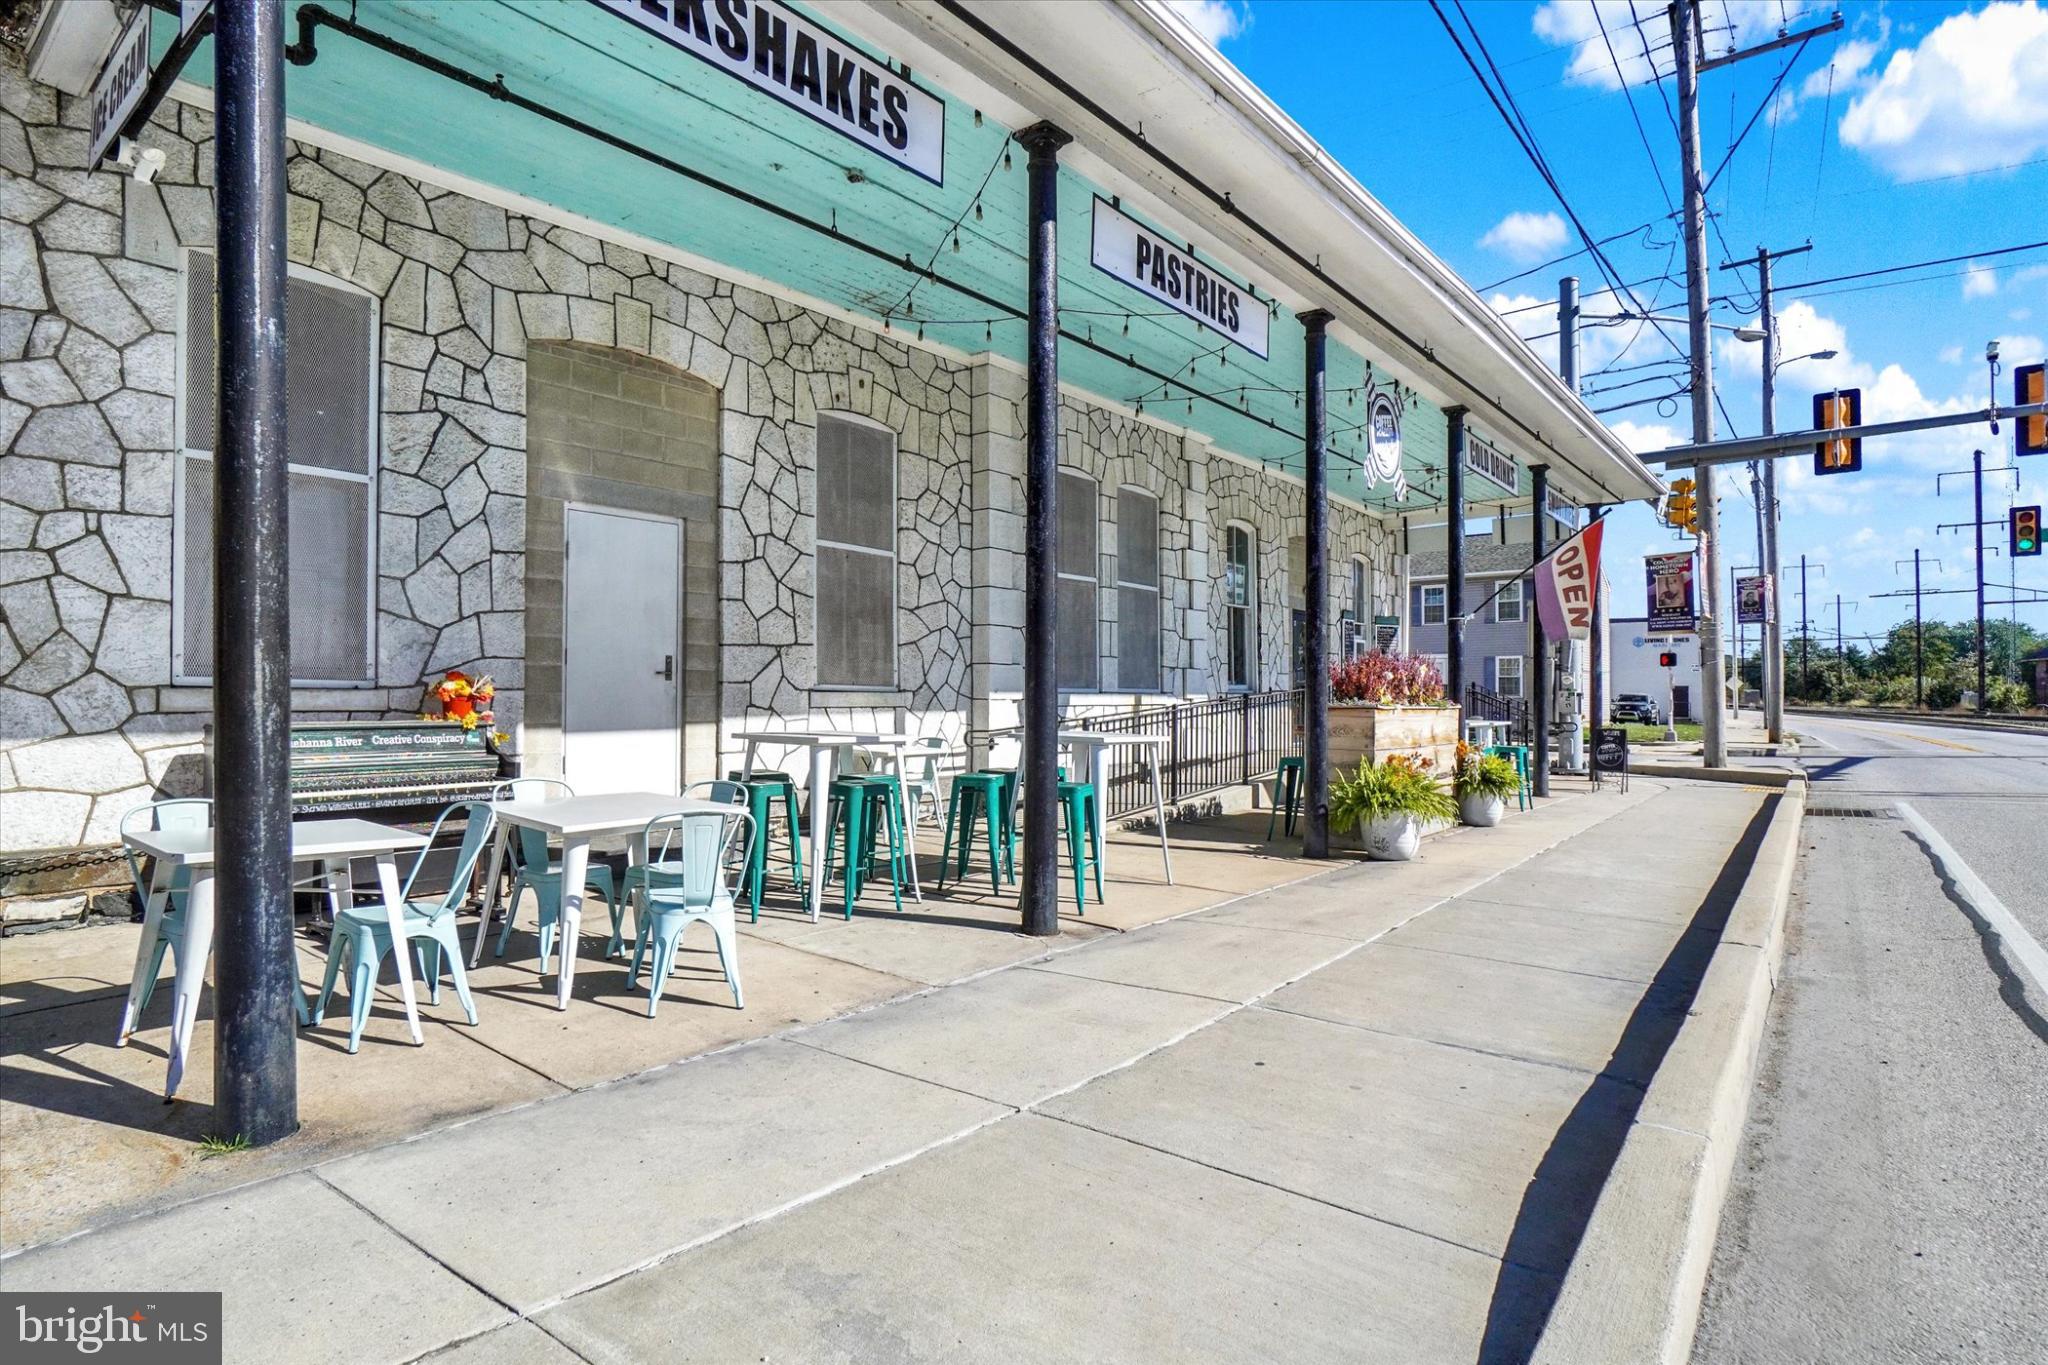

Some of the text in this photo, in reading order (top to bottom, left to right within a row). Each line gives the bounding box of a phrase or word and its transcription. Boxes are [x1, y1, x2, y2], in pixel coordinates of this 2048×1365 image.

[92, 24, 147, 147] ICE CREAM
[1136, 233, 1240, 334] PASTRIES
[1470, 439, 1515, 489] COLD DRINKS
[1556, 545, 1590, 628] OPEN
[334, 736, 363, 747] River
[371, 734, 412, 745] Creative
[413, 733, 465, 746] Conspiracy
